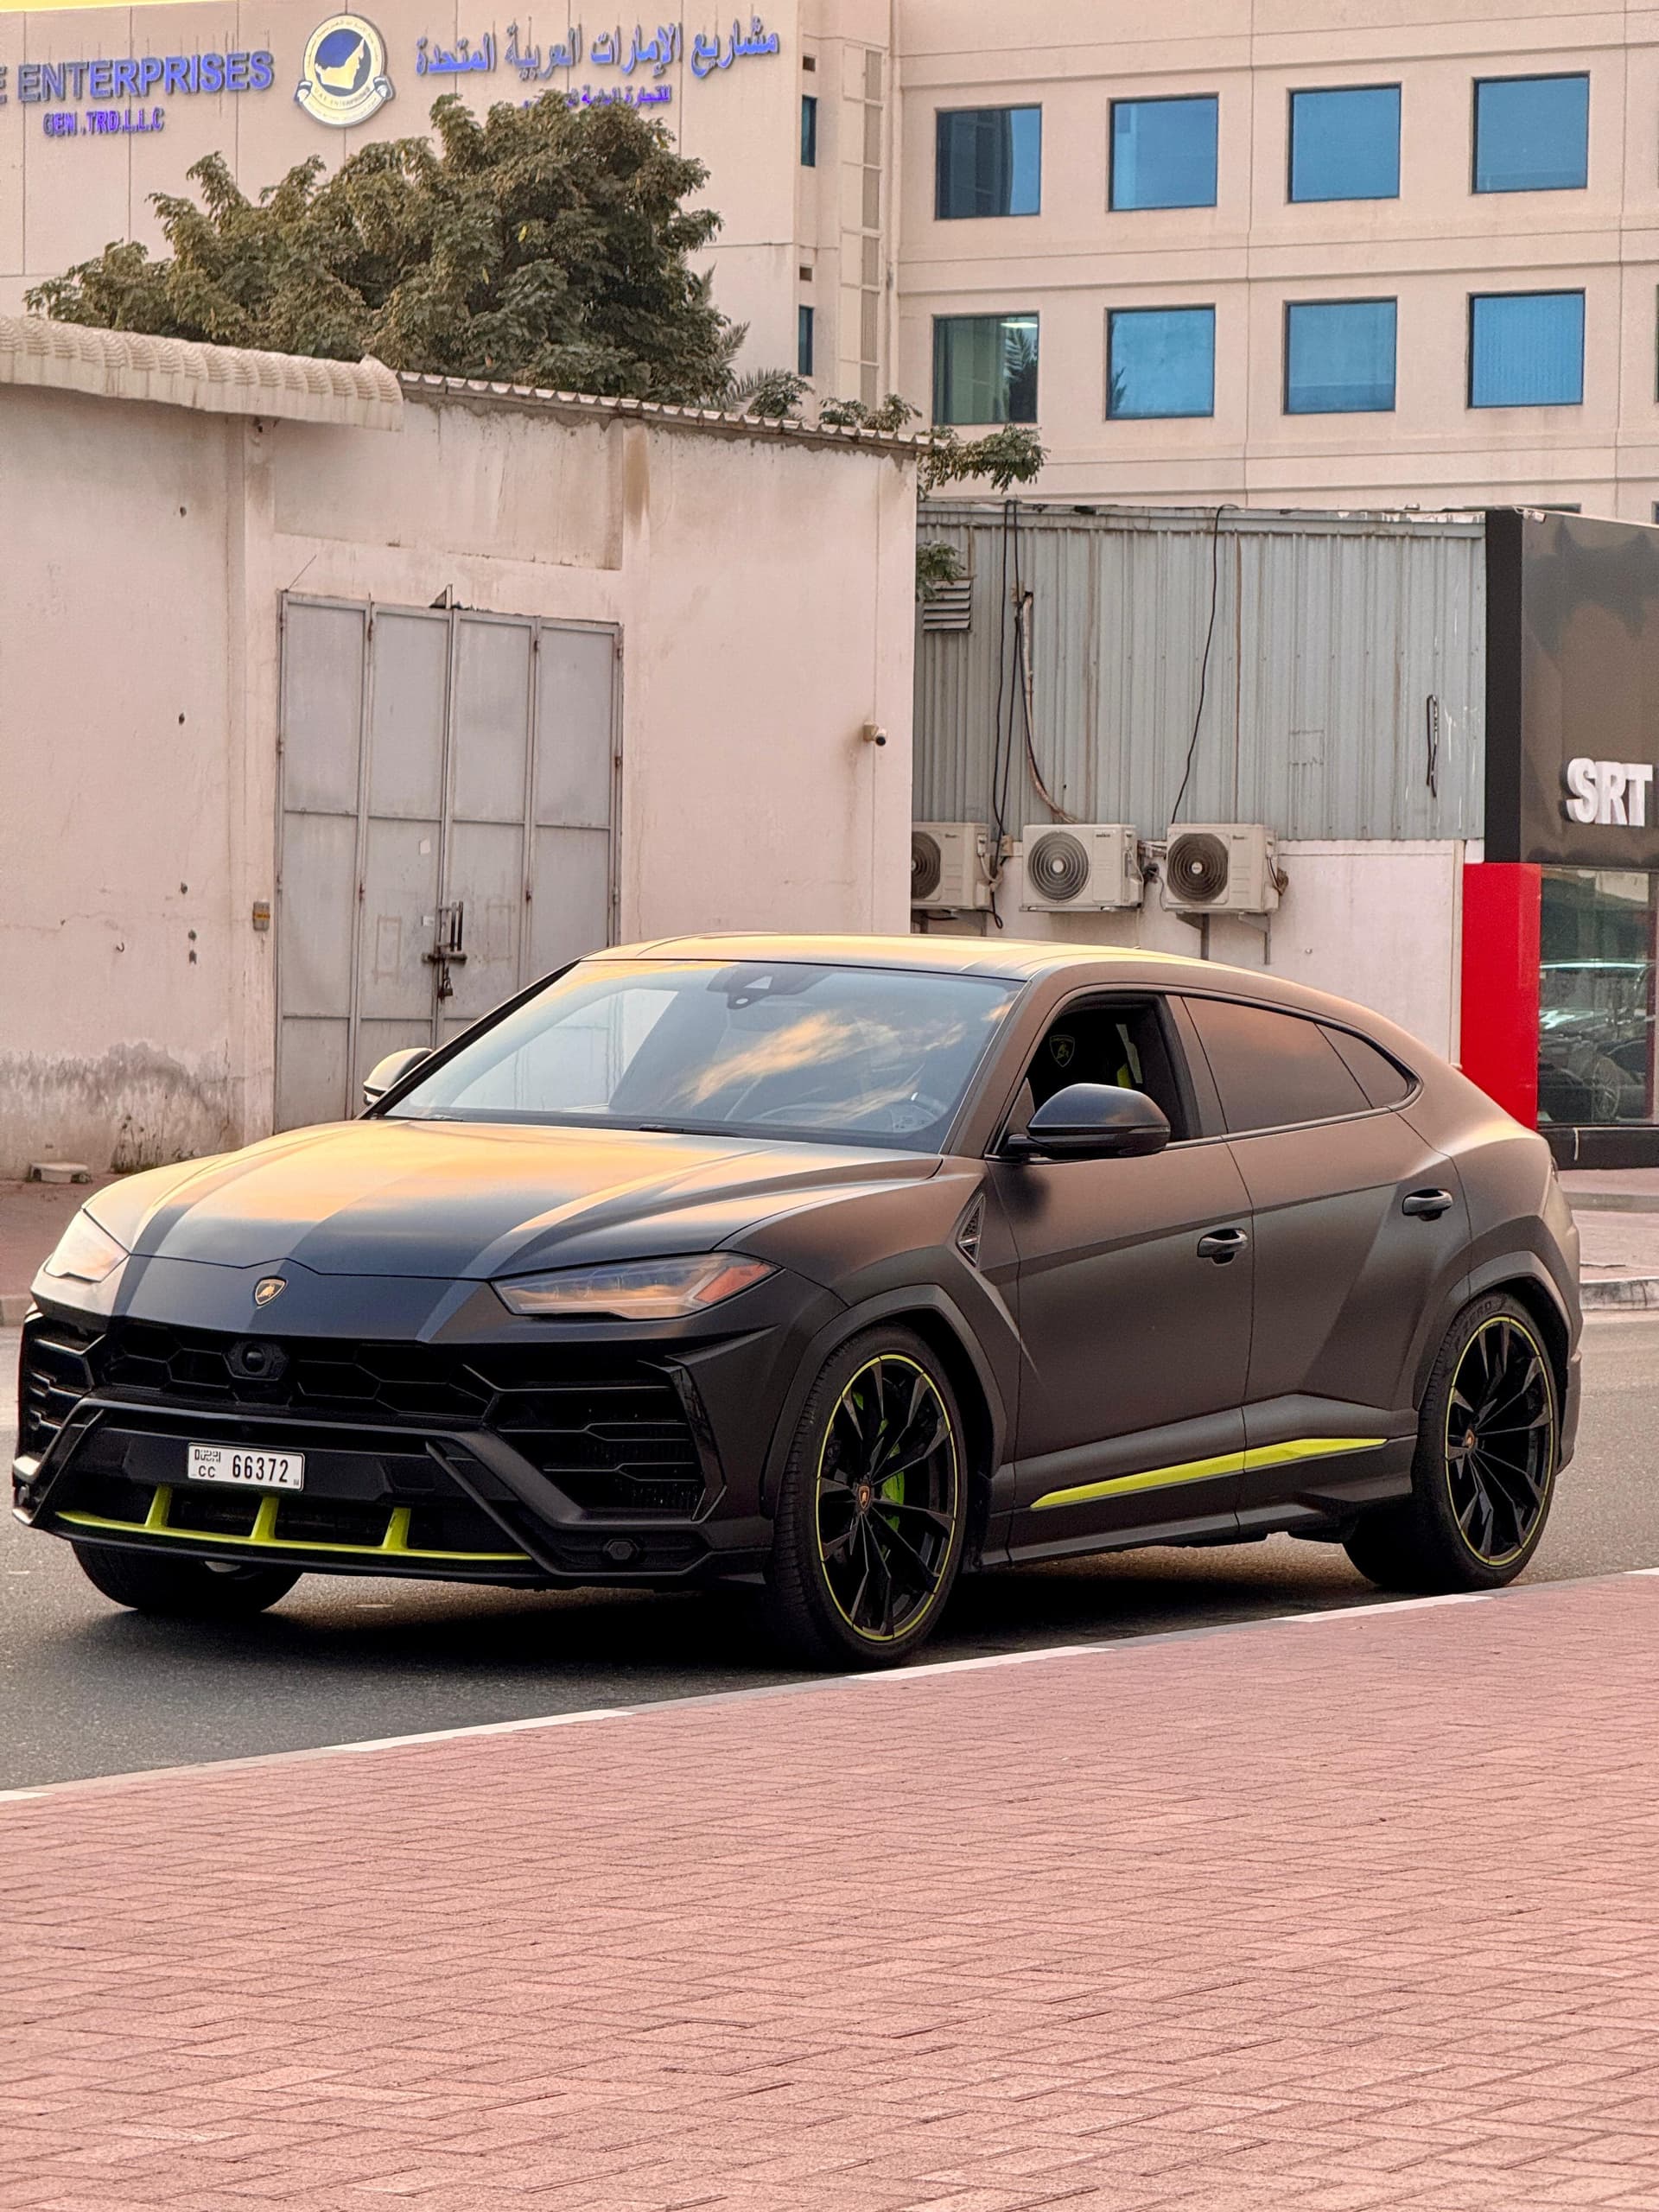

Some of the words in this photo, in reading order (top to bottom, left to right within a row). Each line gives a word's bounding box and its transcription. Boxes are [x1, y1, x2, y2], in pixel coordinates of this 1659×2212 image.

[416, 33, 497, 76] المتحدة
[505, 22, 583, 81] العربية
[590, 22, 683, 79] الإمارات
[691, 16, 779, 79] مشاريع
[17, 50, 274, 102] ENTERPRISES
[1566, 758, 1653, 827] SRT
[198, 1465, 216, 1478] CC
[232, 1454, 289, 1483] 66372
